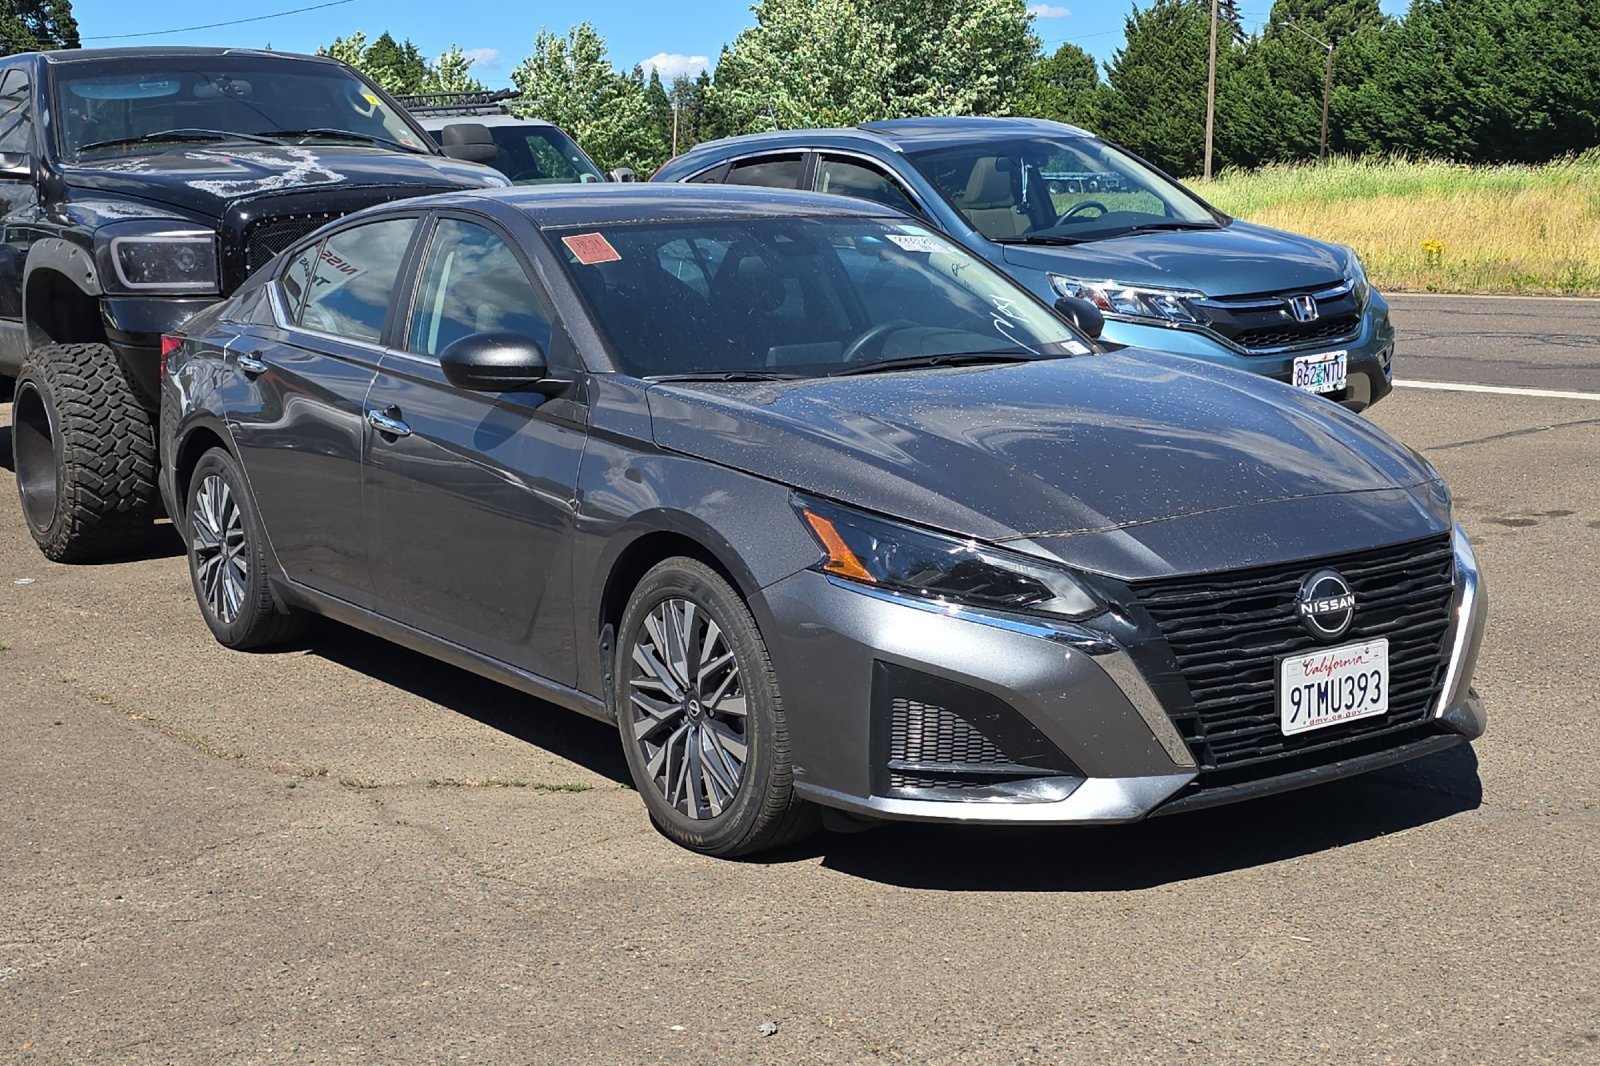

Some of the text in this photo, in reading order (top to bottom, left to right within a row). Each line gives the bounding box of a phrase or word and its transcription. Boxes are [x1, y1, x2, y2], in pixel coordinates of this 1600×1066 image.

[1296, 361, 1344, 387] 862 NTU
[1300, 595, 1355, 615] NISSAN
[1303, 655, 1369, 677] California
[1290, 670, 1382, 723] 9TMU393
[1309, 709, 1363, 726] dmv.ca.gov
